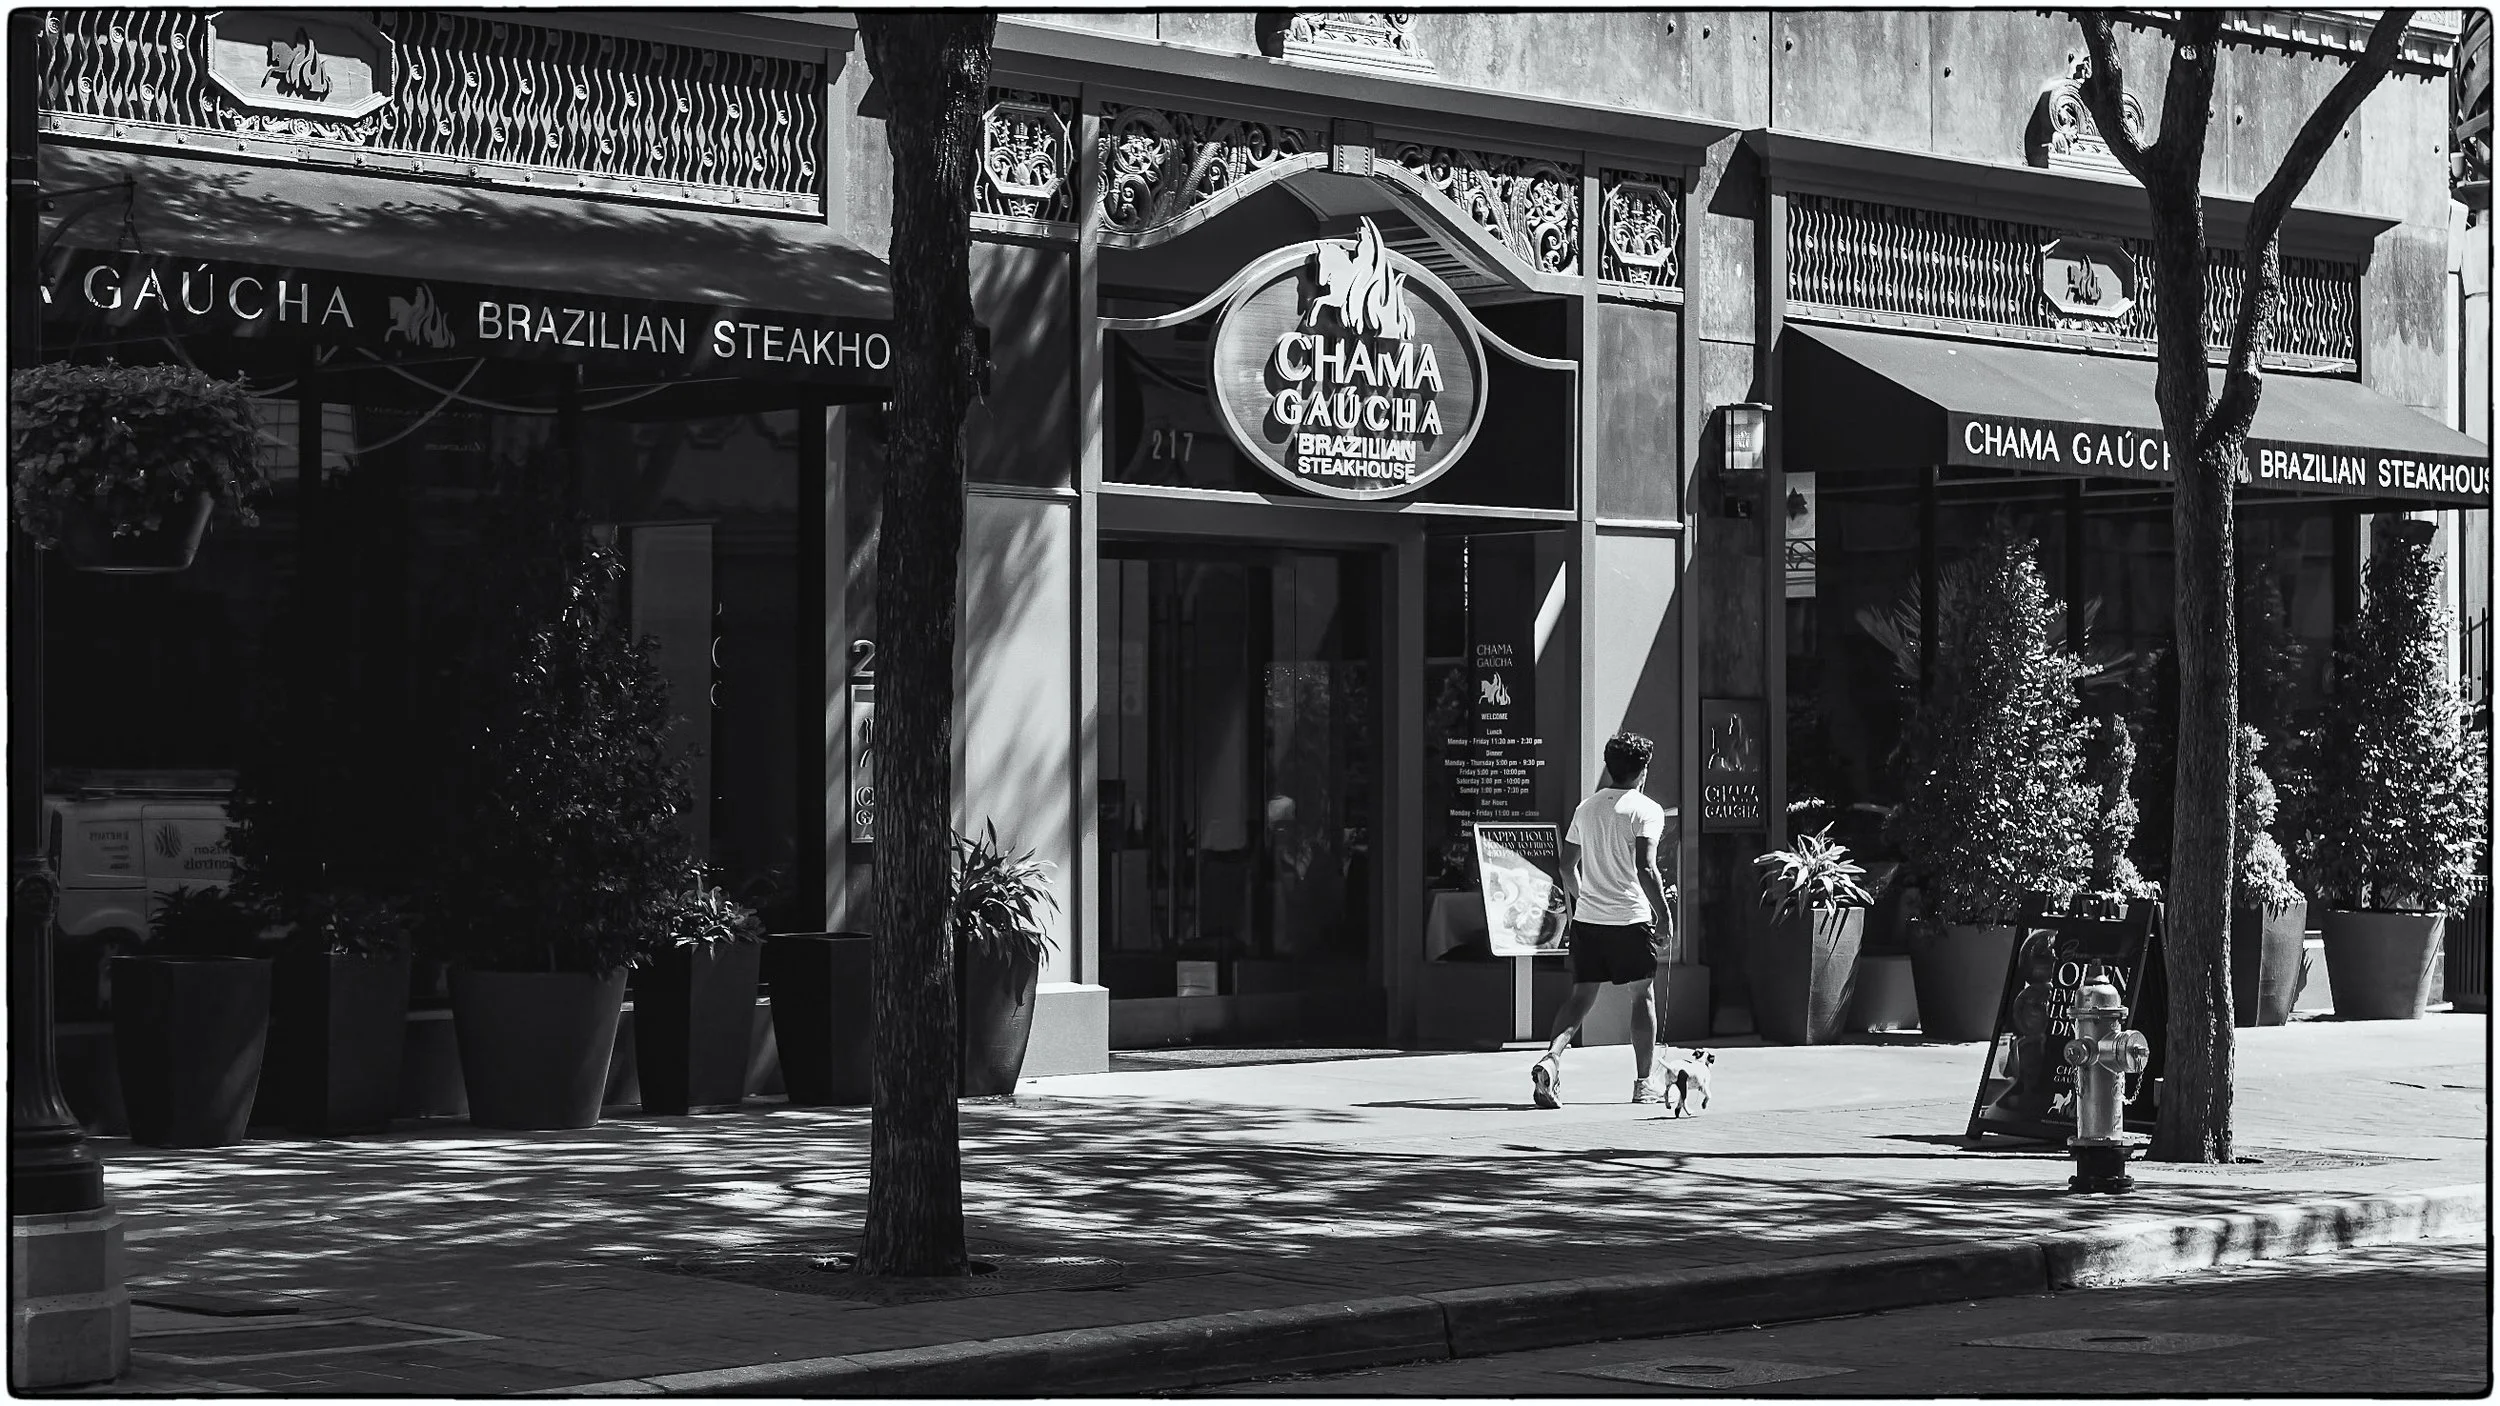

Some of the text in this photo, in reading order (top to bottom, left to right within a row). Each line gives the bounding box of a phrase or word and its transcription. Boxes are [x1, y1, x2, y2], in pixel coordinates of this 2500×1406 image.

[84, 263, 354, 328] GAÚCHA
[479, 301, 891, 370] BRAZILIAN STEAKHO
[1274, 332, 1444, 392] CHAMA
[1273, 386, 1444, 435] GAÚCHA
[1152, 429, 1194, 463] 217
[1296, 432, 1416, 462] BRAZILIAN
[1964, 421, 2060, 462] CHAMA
[1297, 457, 1416, 482] STEAKHOUSE
[2260, 449, 2366, 486] BRAZILIAN
[1476, 644, 1513, 656] CHAMA
[1481, 712, 1508, 720] WELCOME
[1447, 738, 1468, 746] Monday
[1473, 738, 1490, 746] Friday
[1534, 738, 1543, 746] pm
[1444, 760, 1466, 768] Monday
[1471, 760, 1495, 768] Thursday
[1536, 760, 1546, 768] pm
[1459, 769, 1476, 777] Friday
[1460, 787, 1479, 795] Sunday
[1450, 809, 1471, 817] Monday
[1476, 809, 1493, 817] Friday
[1482, 830, 1554, 841] HAPPY HOUR
